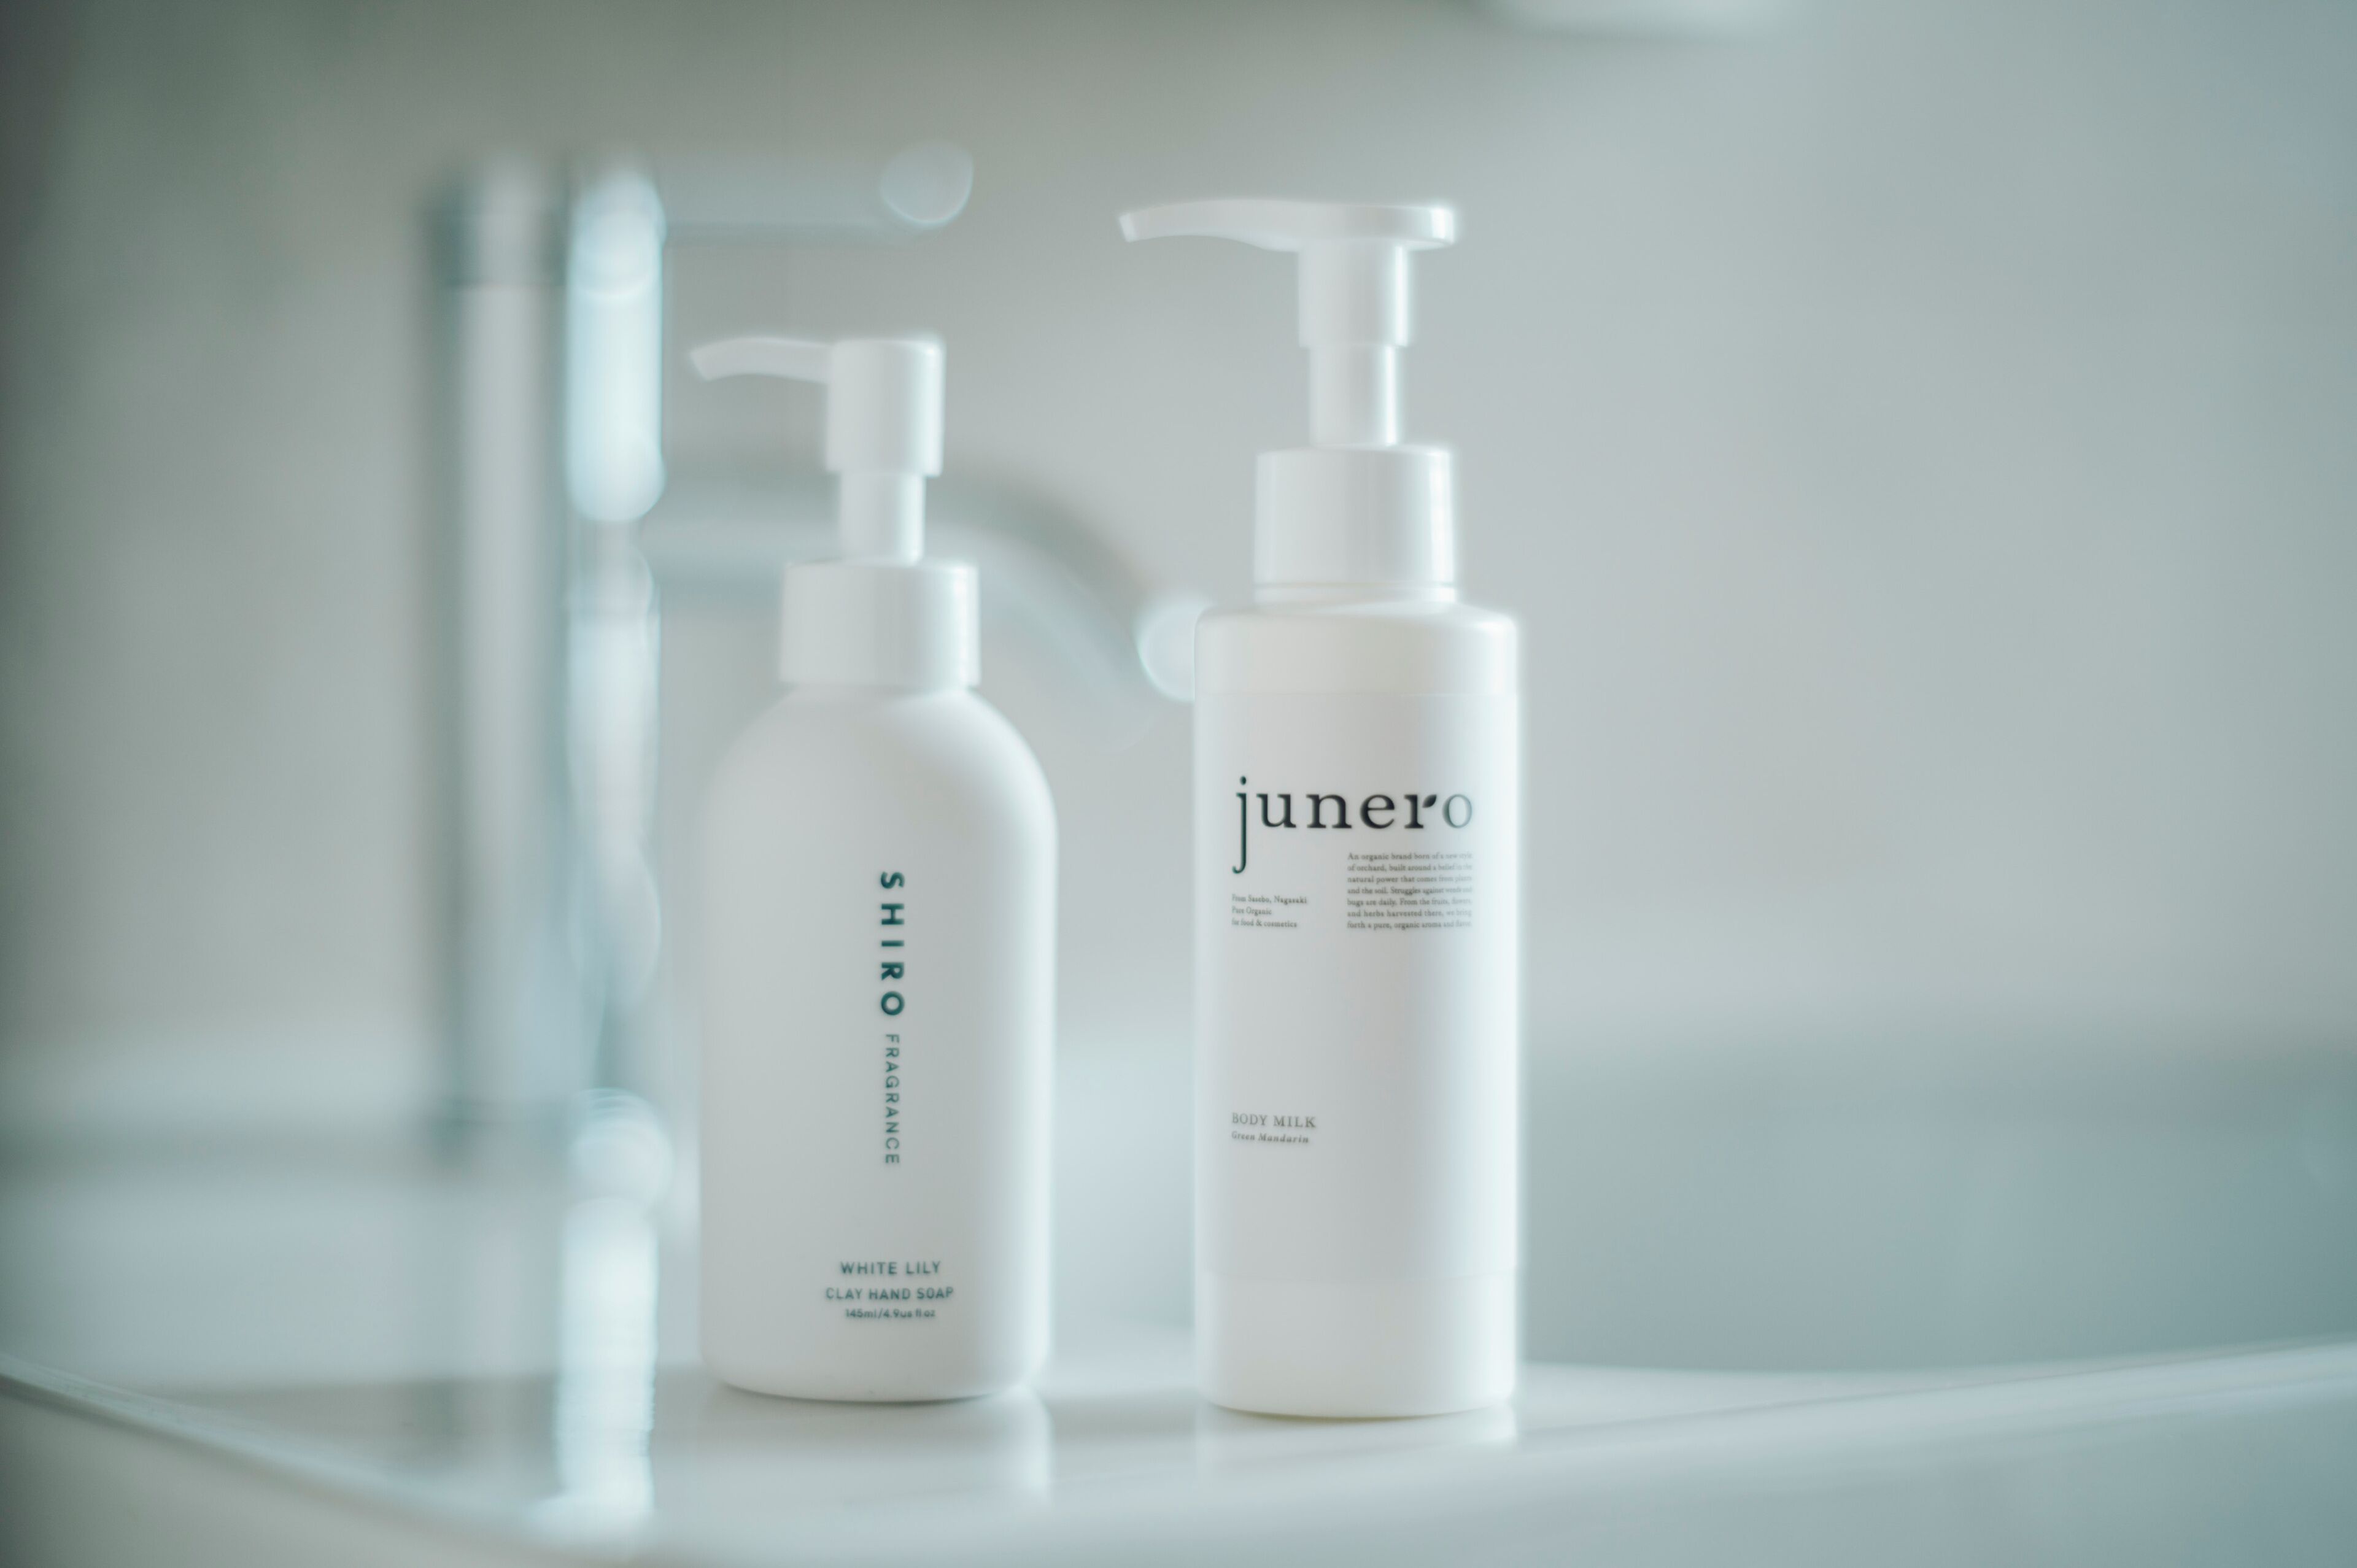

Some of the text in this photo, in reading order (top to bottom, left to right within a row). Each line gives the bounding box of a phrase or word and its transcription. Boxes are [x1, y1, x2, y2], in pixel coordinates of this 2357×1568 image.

[1232, 775, 1473, 874] junero
[1248, 895, 1271, 903] Sasebo,
[1274, 895, 1307, 905] Nagasaki
[1347, 898, 1363, 907] bugs
[1379, 898, 1396, 907] daily.
[1246, 906, 1272, 916] Organic
[1394, 921, 1420, 930] organic
[880, 871, 905, 1164] SHIRO FRAGRANCE
[1232, 1112, 1316, 1128] BODY MILK
[1232, 1131, 1309, 1143] Green Mandarin
[840, 1261, 941, 1274] WHITE LILY
[826, 1286, 954, 1299] CLAY HAND SOAP
